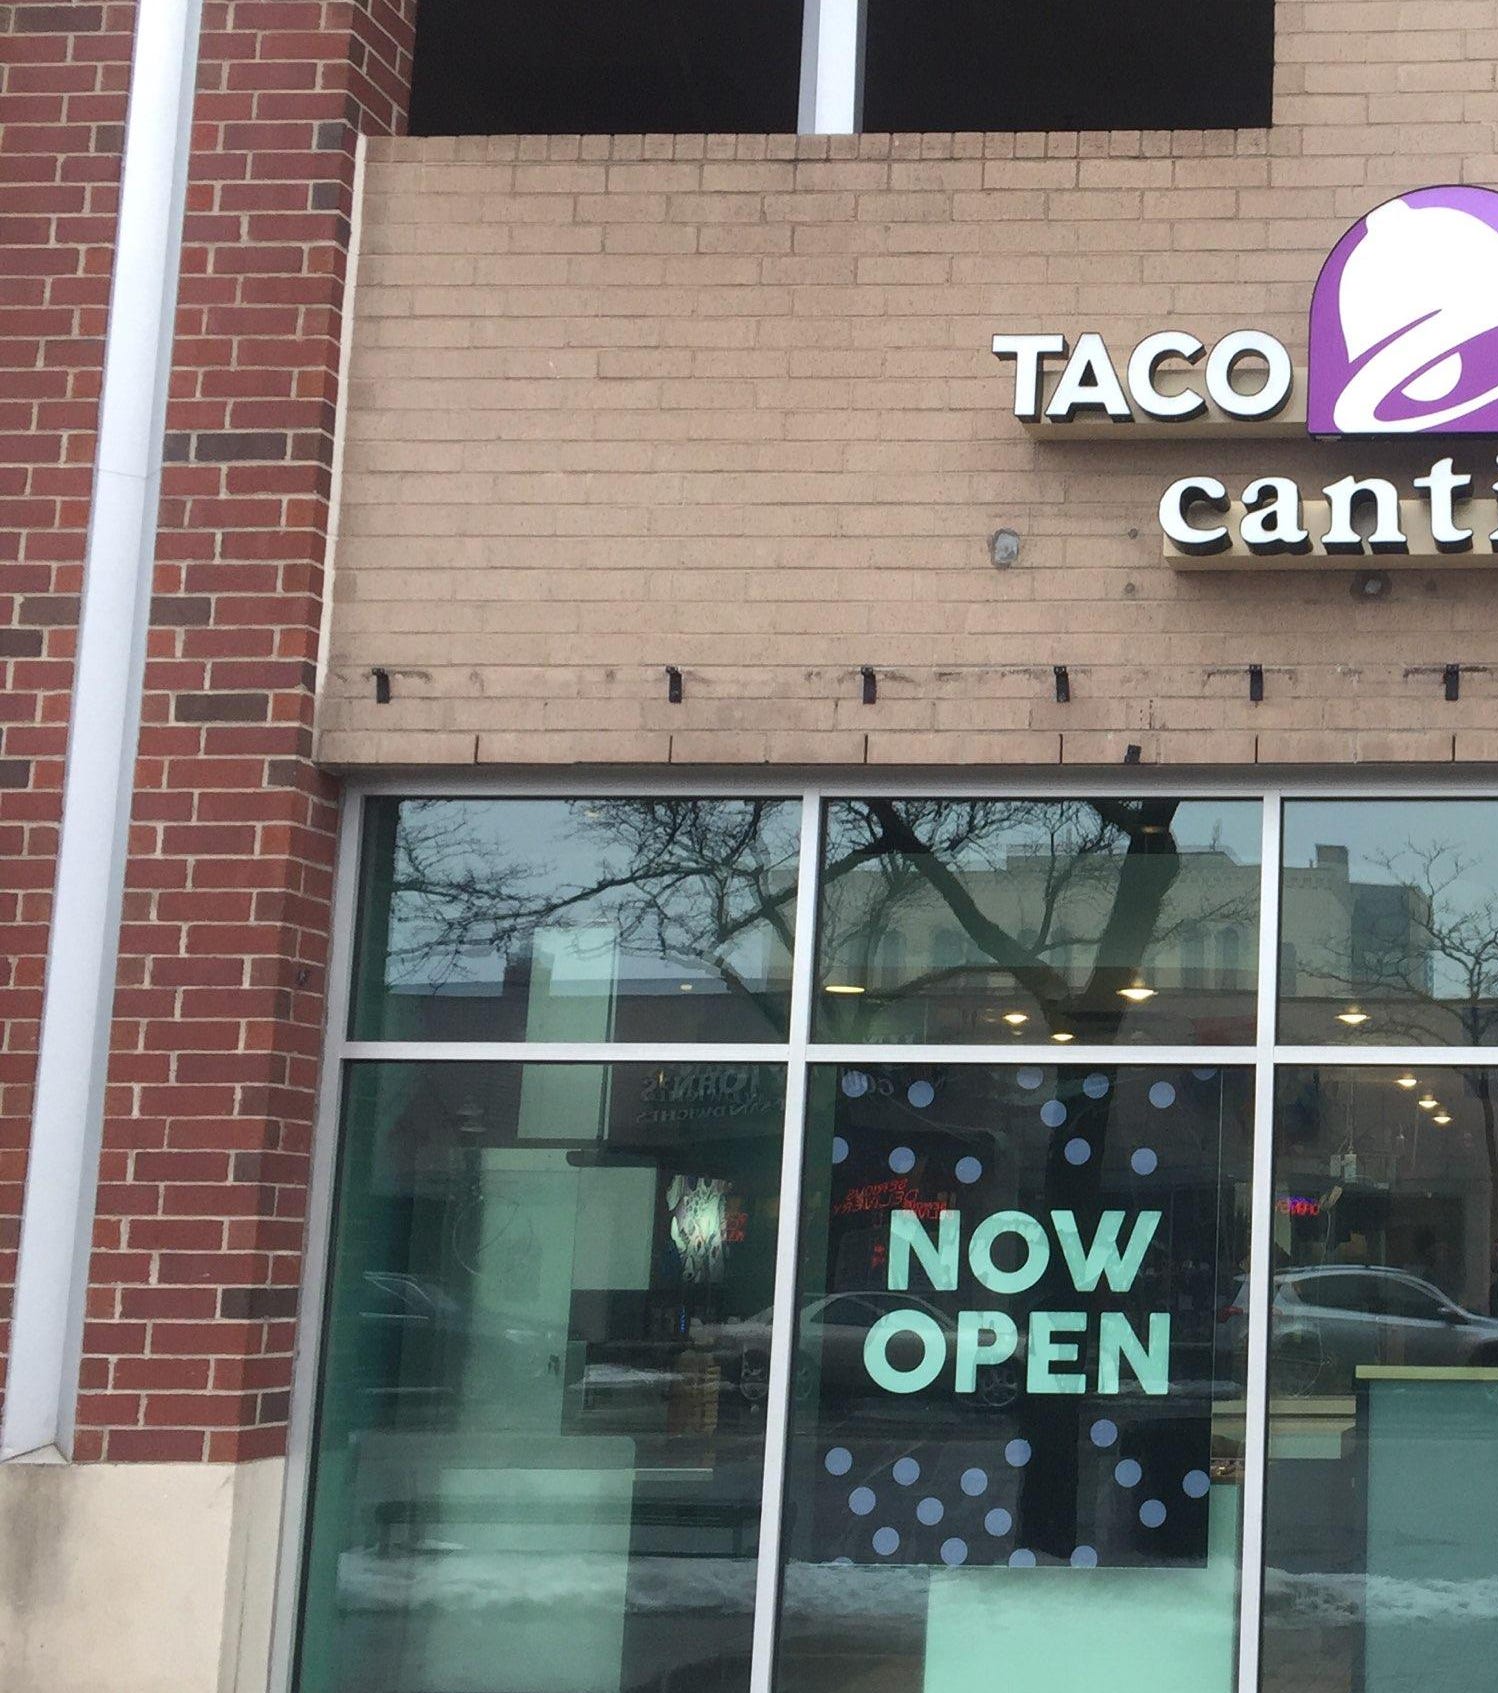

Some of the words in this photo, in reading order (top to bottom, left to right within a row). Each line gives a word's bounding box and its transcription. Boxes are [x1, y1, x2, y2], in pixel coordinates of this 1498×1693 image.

[991, 330, 1294, 422] TACO
[887, 1209, 1162, 1294] NOW
[863, 1308, 1171, 1395] OPEN
